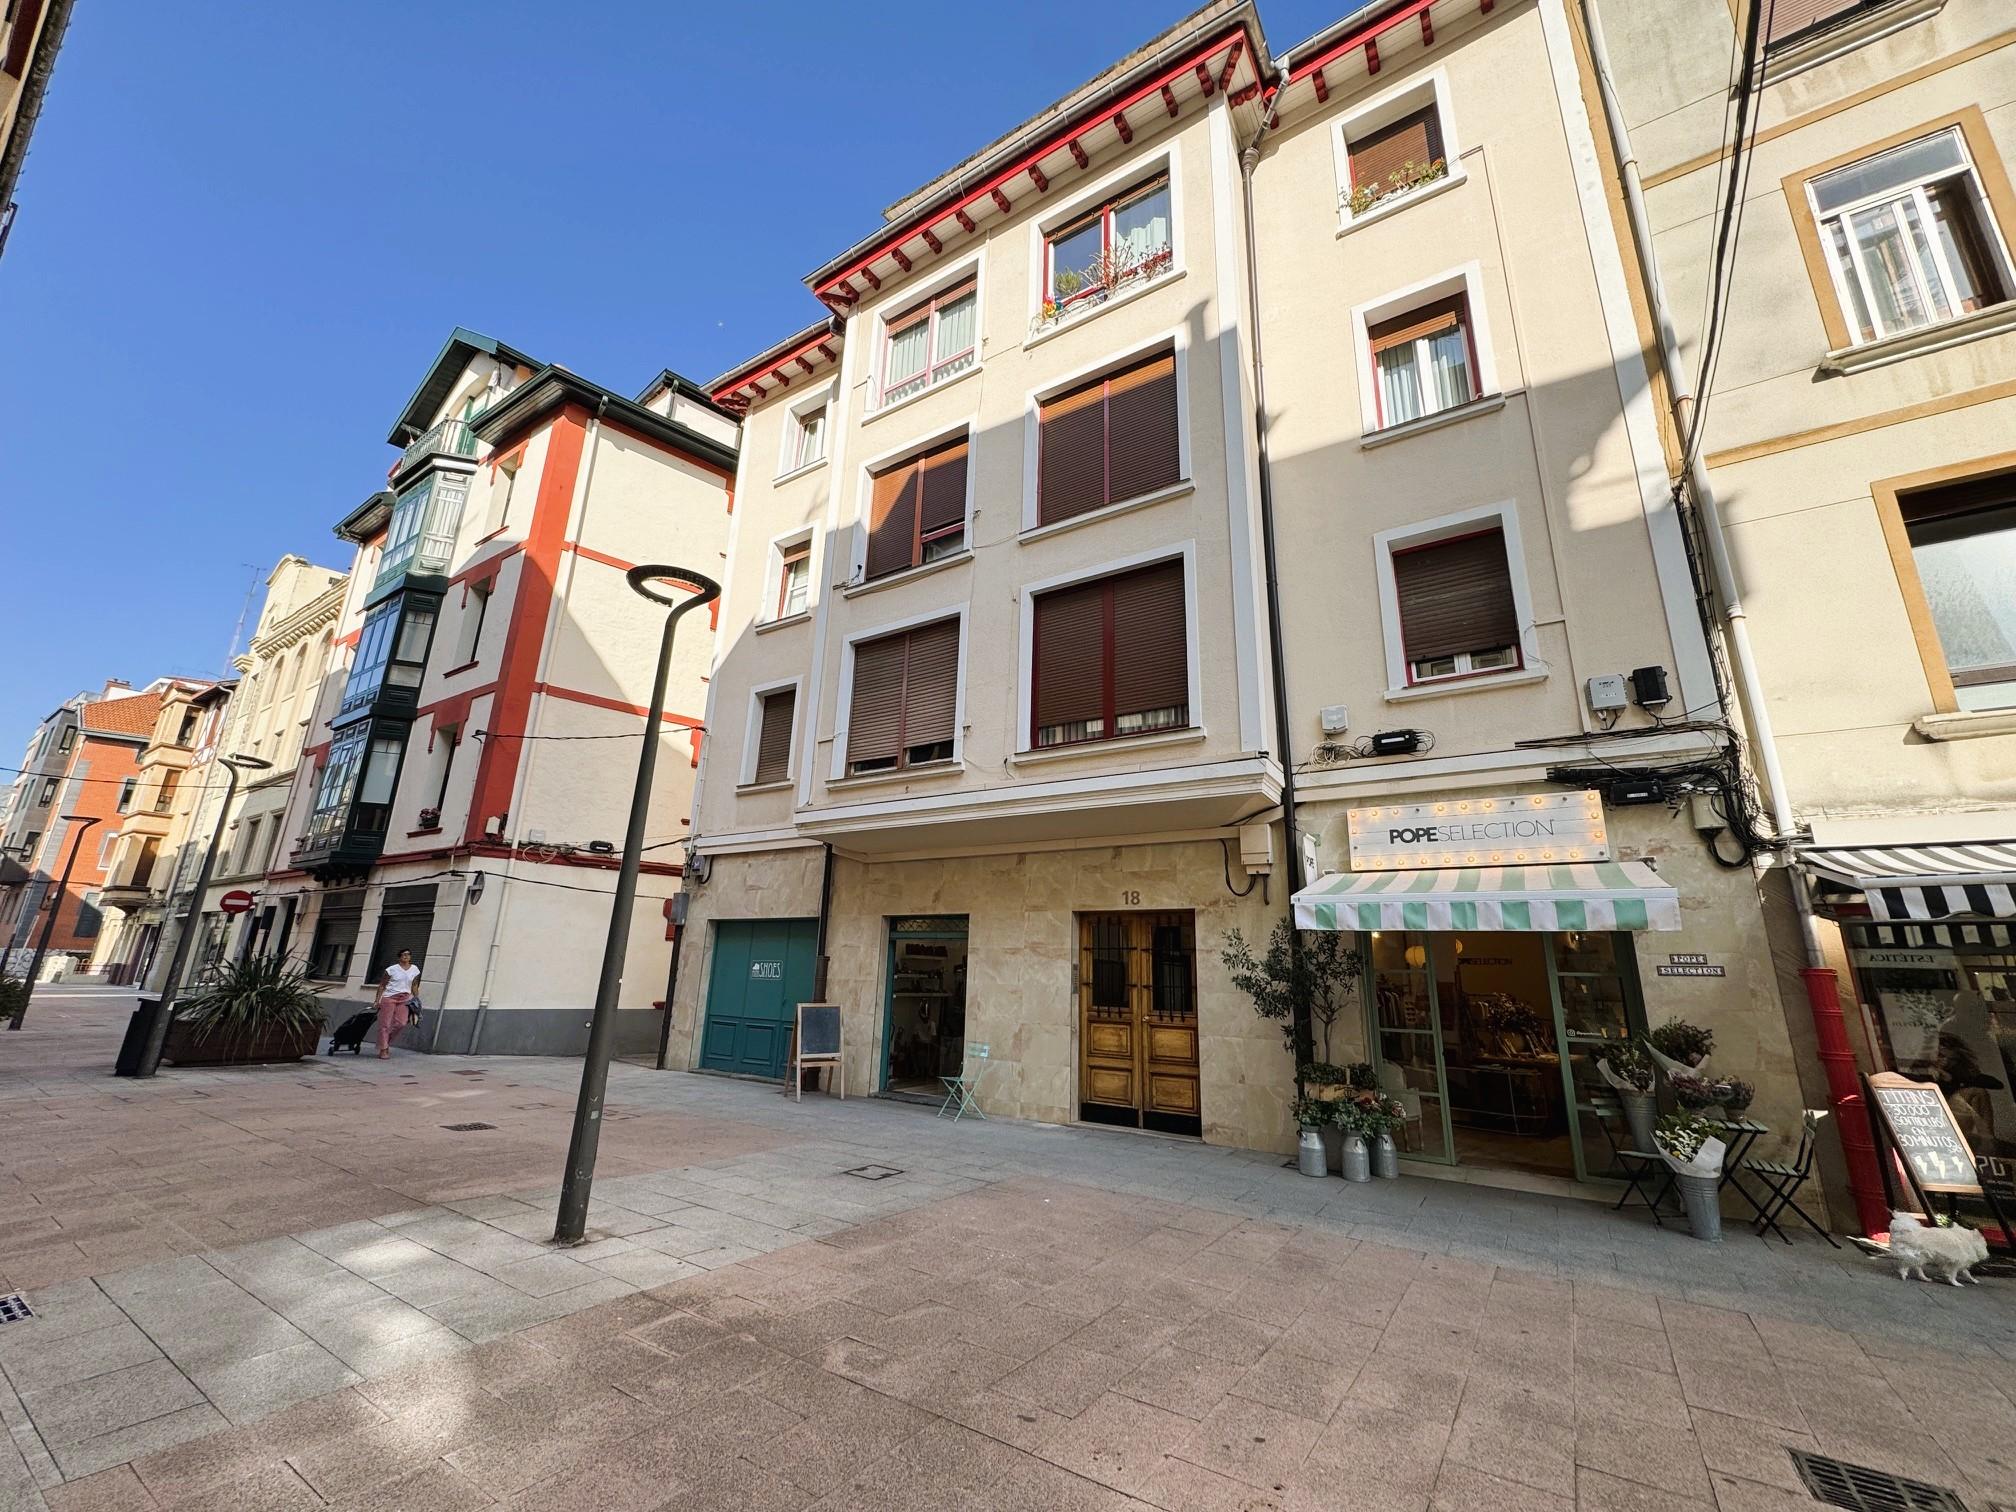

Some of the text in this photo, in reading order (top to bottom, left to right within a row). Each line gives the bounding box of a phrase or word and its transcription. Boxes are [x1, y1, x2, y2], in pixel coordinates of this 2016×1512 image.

[1122, 890, 1141, 905] 18
[760, 962, 781, 978] SHOES
[1663, 967, 1719, 975] SELECTION
